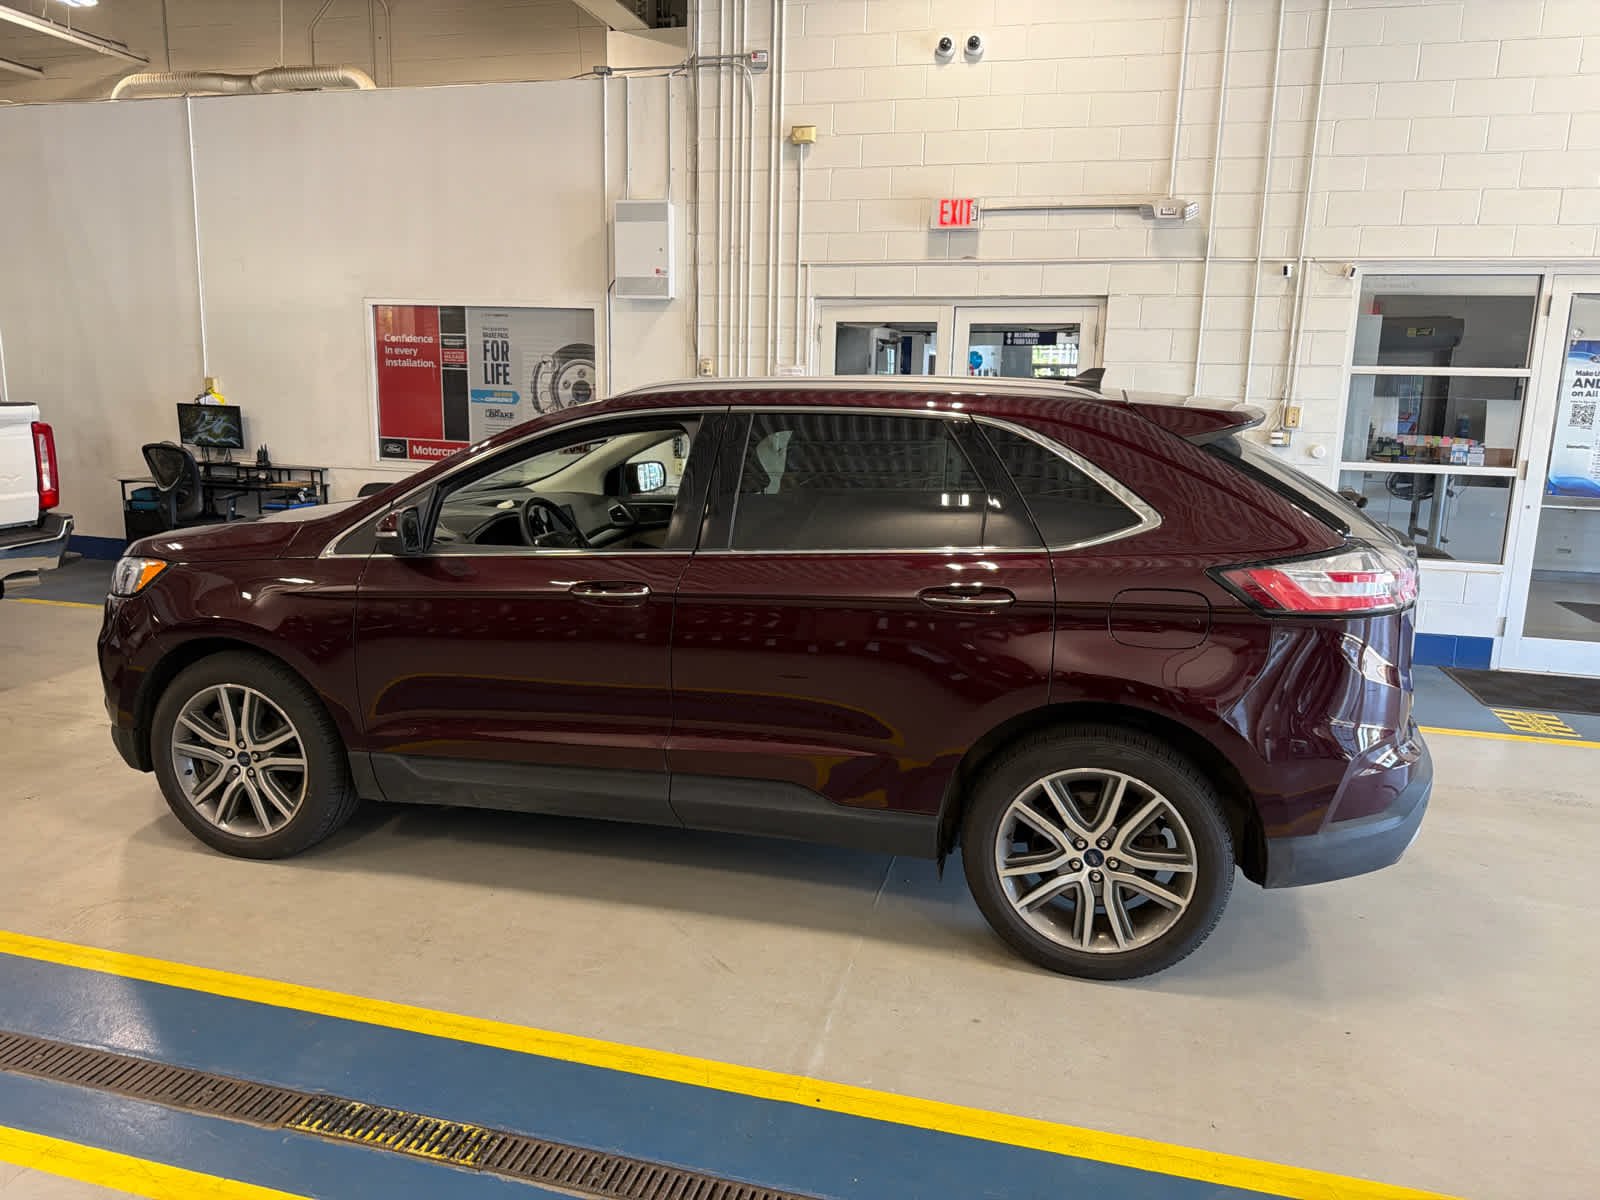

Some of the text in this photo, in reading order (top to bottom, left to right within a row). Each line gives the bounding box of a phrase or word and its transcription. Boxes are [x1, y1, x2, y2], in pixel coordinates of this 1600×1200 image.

[939, 199, 974, 225] EXIT
[384, 334, 434, 343] Confidence
[394, 347, 418, 357] every
[483, 340, 510, 361] FOR
[385, 359, 437, 368] installation.
[484, 363, 512, 385] LIFE.
[412, 445, 465, 457] Motorcraf
